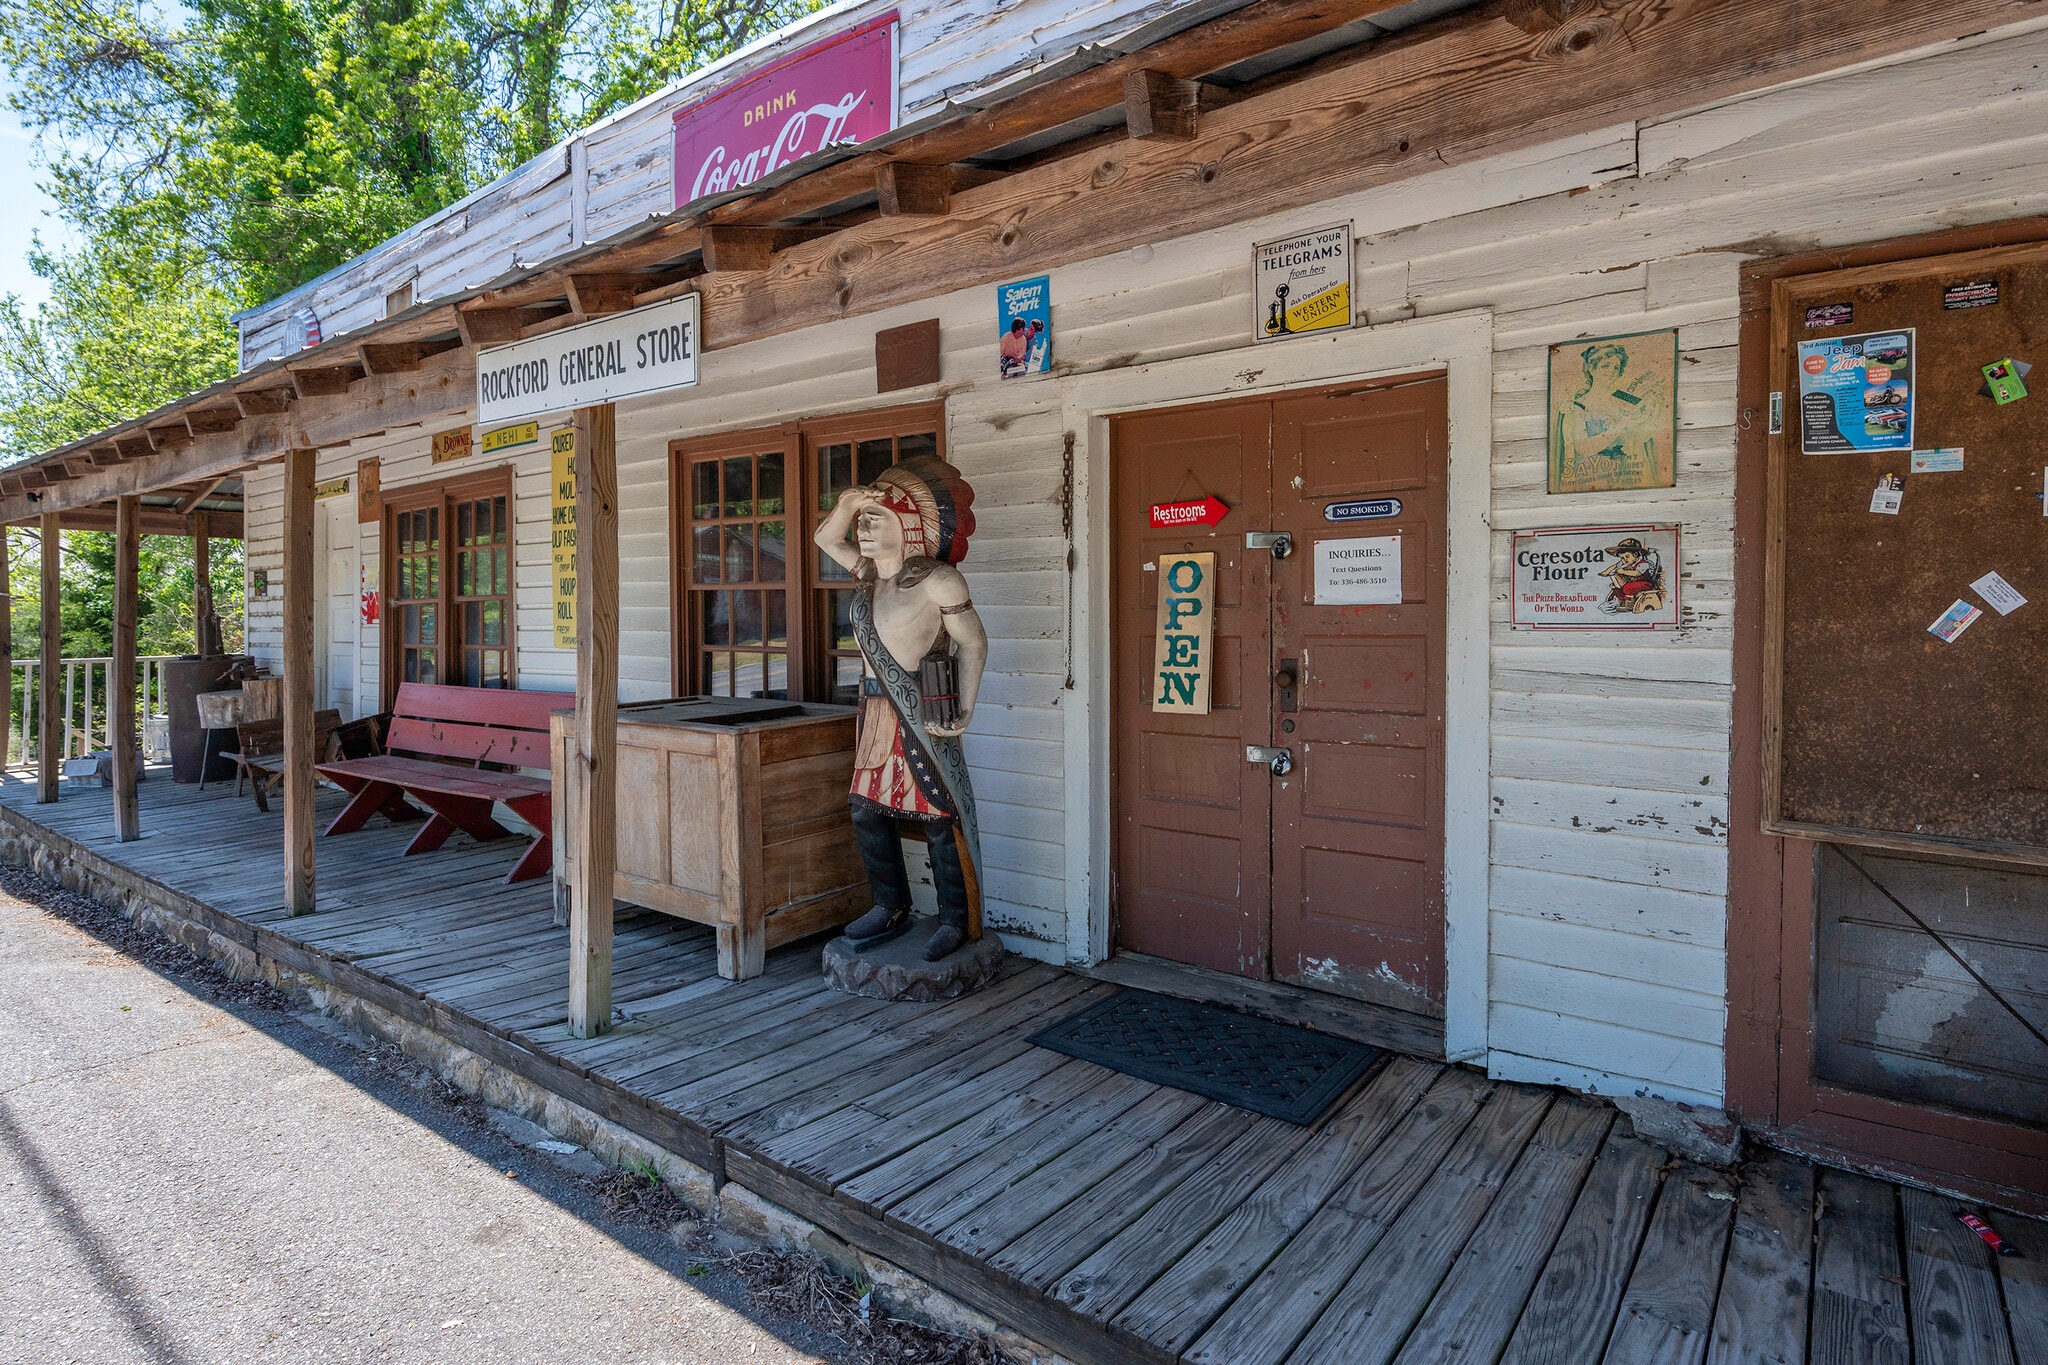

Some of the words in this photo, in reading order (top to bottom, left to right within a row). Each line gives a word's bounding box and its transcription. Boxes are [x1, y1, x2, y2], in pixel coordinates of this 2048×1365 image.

[743, 88, 797, 128] DRINK
[1264, 238, 1312, 256] TELEPHONE
[1316, 232, 1341, 244] YOUR
[1263, 243, 1342, 271] TELEGRAMS
[1289, 268, 1308, 279] from
[1309, 264, 1327, 274] here
[1005, 284, 1042, 303] Salem
[1290, 297, 1301, 307] Ask
[1302, 284, 1329, 302] Operator
[1329, 280, 1339, 288] for
[1945, 287, 1998, 298] PRECISION
[1008, 298, 1040, 316] Spirit
[1292, 290, 1341, 318] WESTERN
[1302, 300, 1337, 322] UNION
[1814, 340, 1838, 348] Annual
[1823, 343, 1863, 356] Jeep
[481, 358, 549, 404] ROCKFORD
[559, 339, 627, 386] GENERAL
[636, 321, 691, 369] STORE
[1830, 354, 1866, 373] Jam
[442, 433, 470, 453] BROWNIE
[496, 428, 518, 446] NEHI
[552, 432, 574, 454] CURED
[560, 480, 576, 500] MOL
[552, 506, 567, 525] HOME
[1153, 503, 1207, 522] Restrooms
[1336, 507, 1349, 516] NO
[1350, 505, 1388, 515] SMOKING
[552, 530, 562, 548] OLD
[1517, 546, 1606, 568] Ceresota
[1348, 565, 1382, 574] Questions
[1532, 565, 1589, 582] Flour
[560, 577, 576, 596] HOOP
[1341, 577, 1387, 586] 336-486-3510
[1521, 593, 1535, 603] THE
[1535, 593, 1554, 603] PRIZE
[1555, 593, 1577, 603] BREAD
[1577, 592, 1598, 602] FLOUR
[557, 601, 573, 620] ROLL
[1534, 604, 1544, 613] OF
[1545, 604, 1558, 613] THE
[1559, 603, 1585, 613] WORLD
[1158, 560, 1204, 706] OPEN
